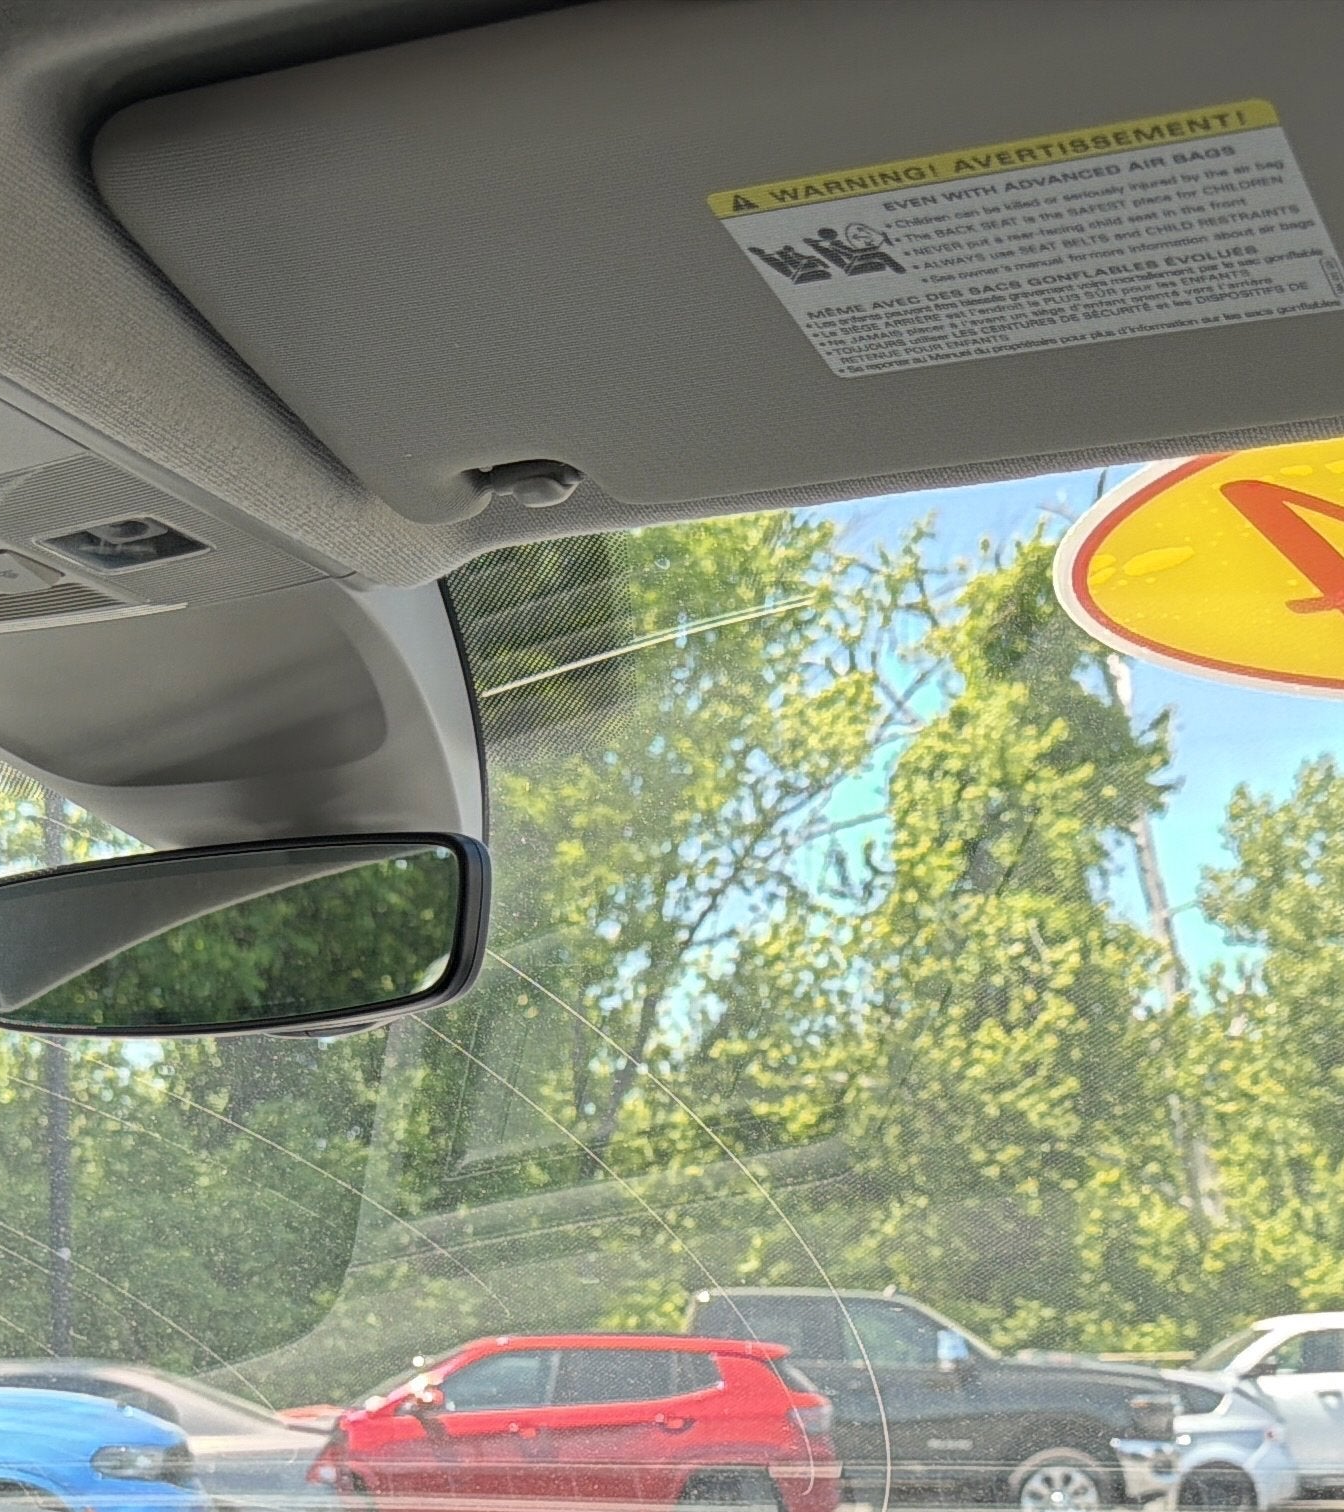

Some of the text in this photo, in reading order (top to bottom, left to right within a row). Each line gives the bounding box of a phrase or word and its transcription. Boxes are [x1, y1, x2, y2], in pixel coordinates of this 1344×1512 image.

[769, 110, 1248, 203] WARNING! AVERTISSEMENT!
[881, 144, 1236, 212] EVEN WITH ADVANCED AIR BAGS
[893, 157, 1285, 228] Children can be killed or seriously injured by the air bag
[903, 174, 1284, 242] The BACK SEAT is the SAFEST place for CHILDREN
[911, 241, 963, 256] NEVER
[965, 237, 992, 250] put
[1005, 222, 1085, 244] rear-facing
[1086, 216, 1123, 229] child
[1125, 210, 1158, 223] seat
[1161, 207, 1177, 217] in
[1180, 203, 1206, 214] the
[1208, 196, 1248, 210] front
[920, 203, 1300, 270] ALWAYS use SEAT BELTS and CHILD RESTRAINTS
[805, 243, 1259, 320] MÊME AVEC DES SACS GONFLABLES ÉVOLUÉS
